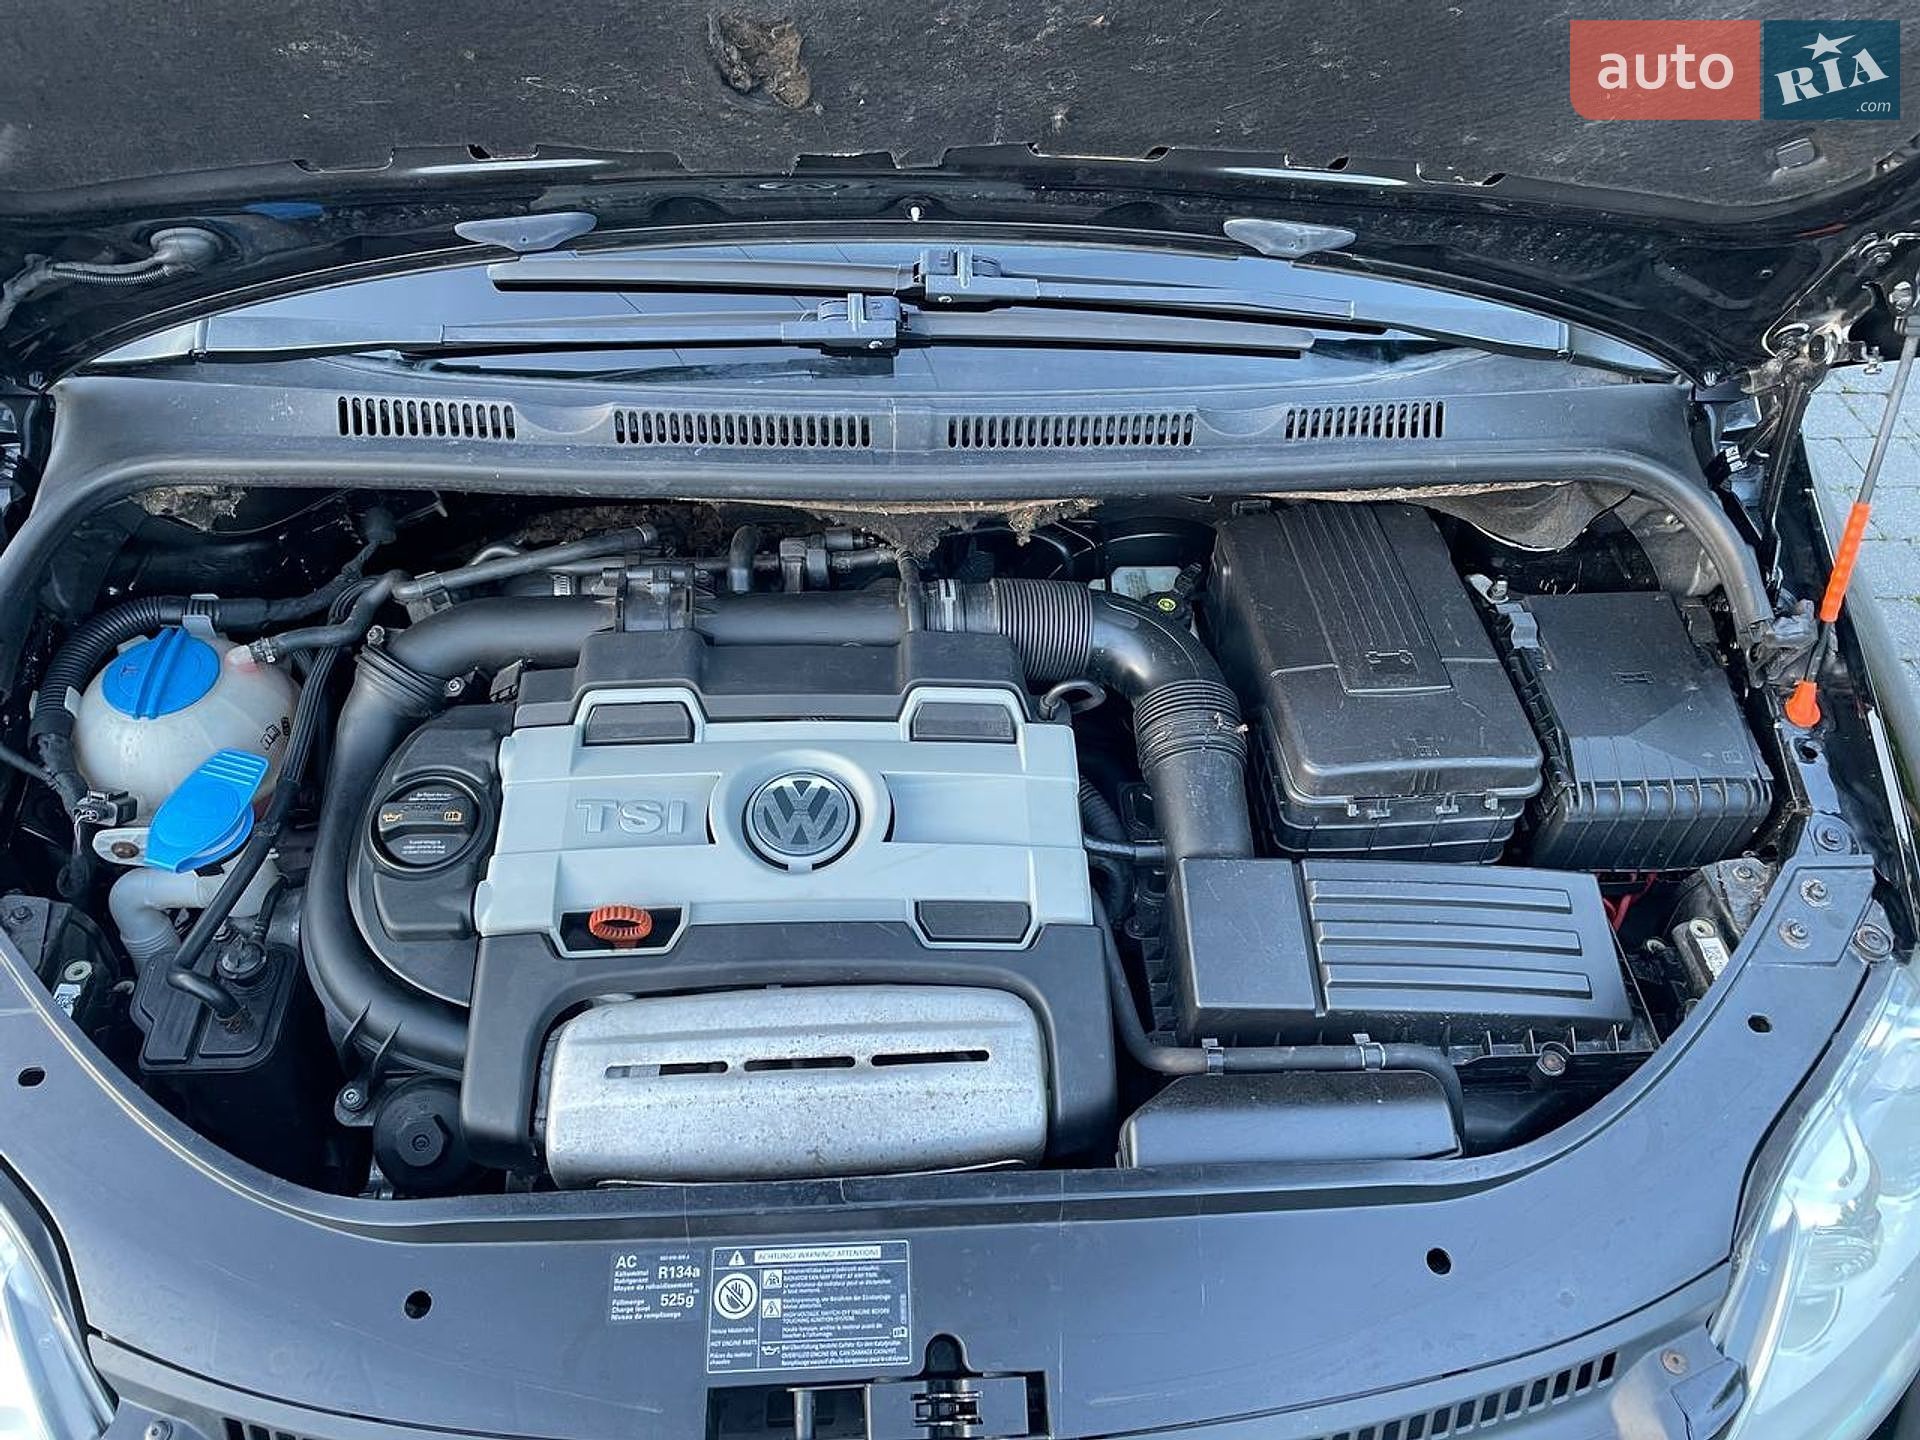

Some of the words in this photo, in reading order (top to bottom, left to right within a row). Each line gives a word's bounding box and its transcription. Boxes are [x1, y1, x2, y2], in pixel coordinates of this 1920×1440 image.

[575, 799, 687, 836] TSI
[616, 1255, 637, 1269] AC
[658, 1265, 700, 1279] R134a
[660, 1293, 695, 1308] 525g
